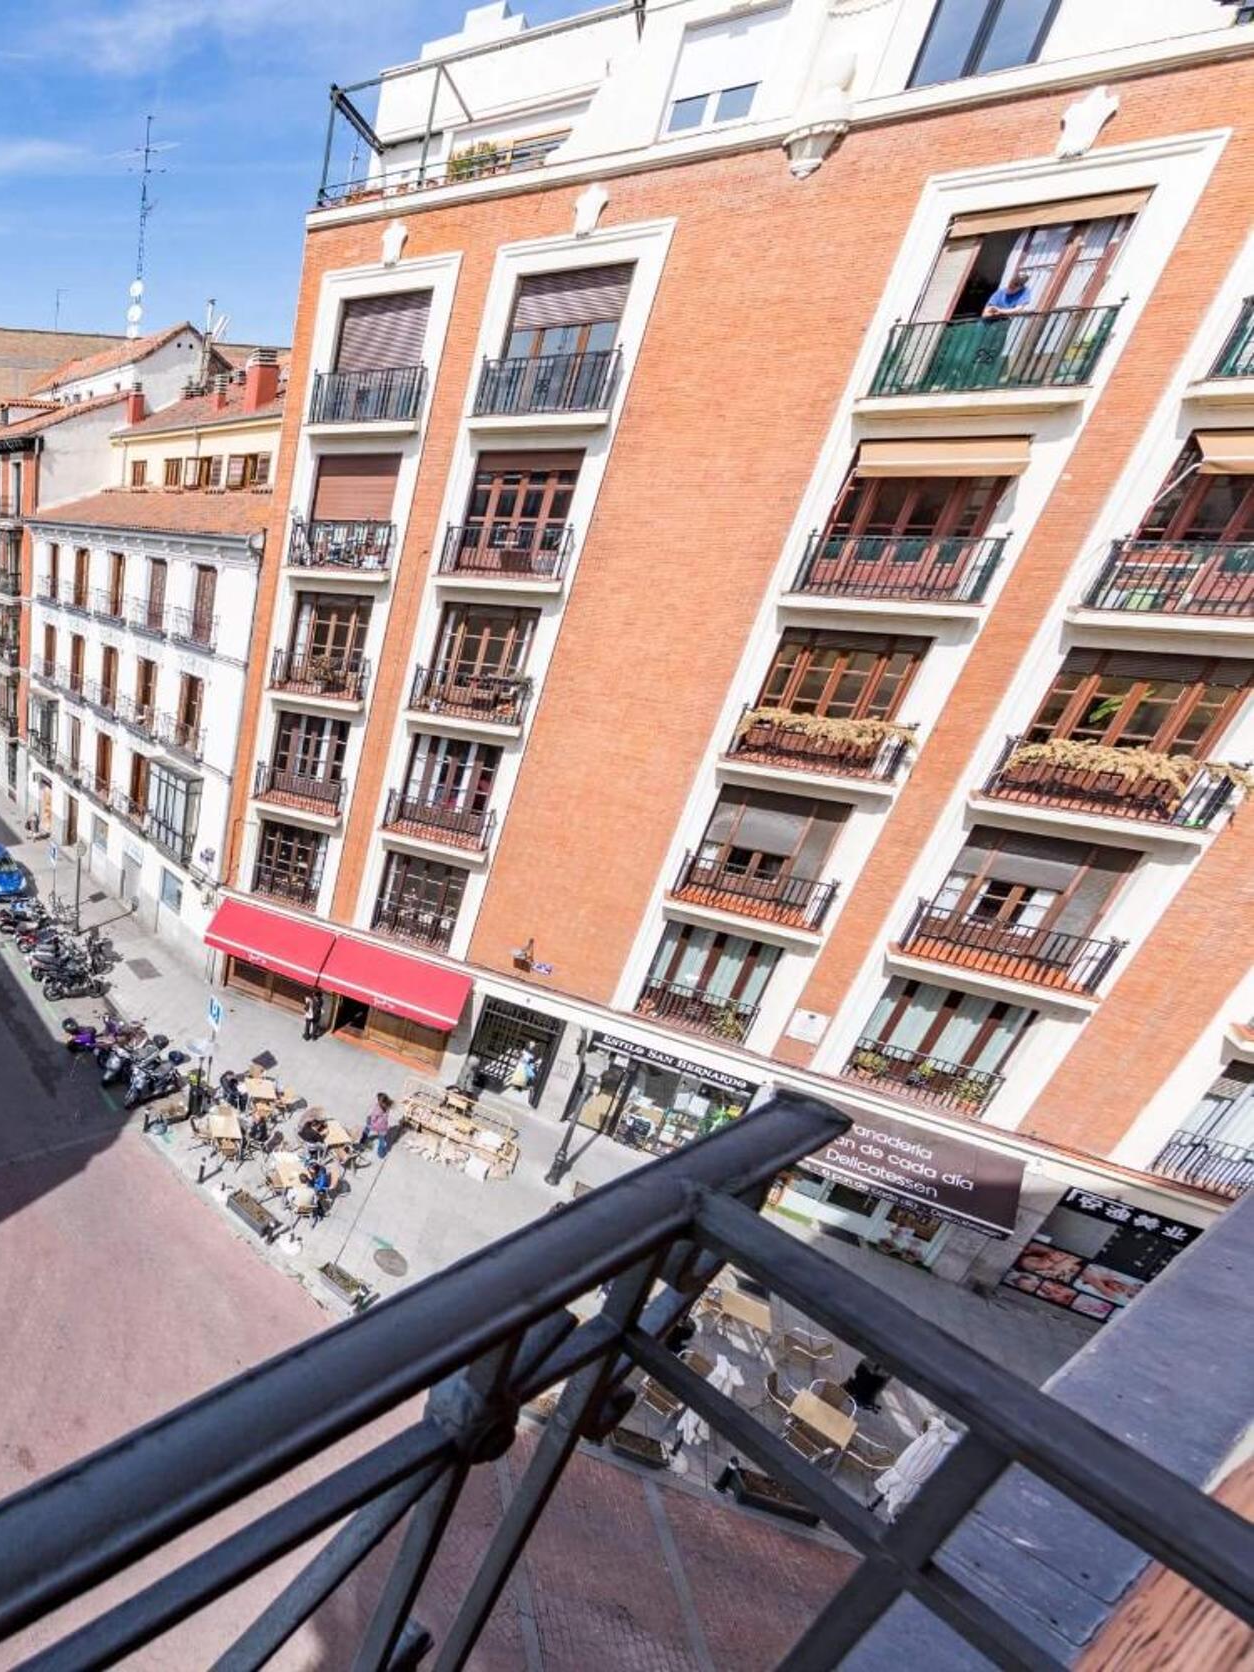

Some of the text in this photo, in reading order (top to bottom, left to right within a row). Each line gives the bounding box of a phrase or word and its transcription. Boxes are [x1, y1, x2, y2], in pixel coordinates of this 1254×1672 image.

[648, 1049, 674, 1065] SAN
[677, 1059, 747, 1088] BERNARDO
[852, 1123, 933, 1160] anadería
[825, 1149, 938, 1198] Delicatessen
[860, 1142, 884, 1159] de
[888, 1152, 937, 1179] cada
[941, 1168, 975, 1192] día
